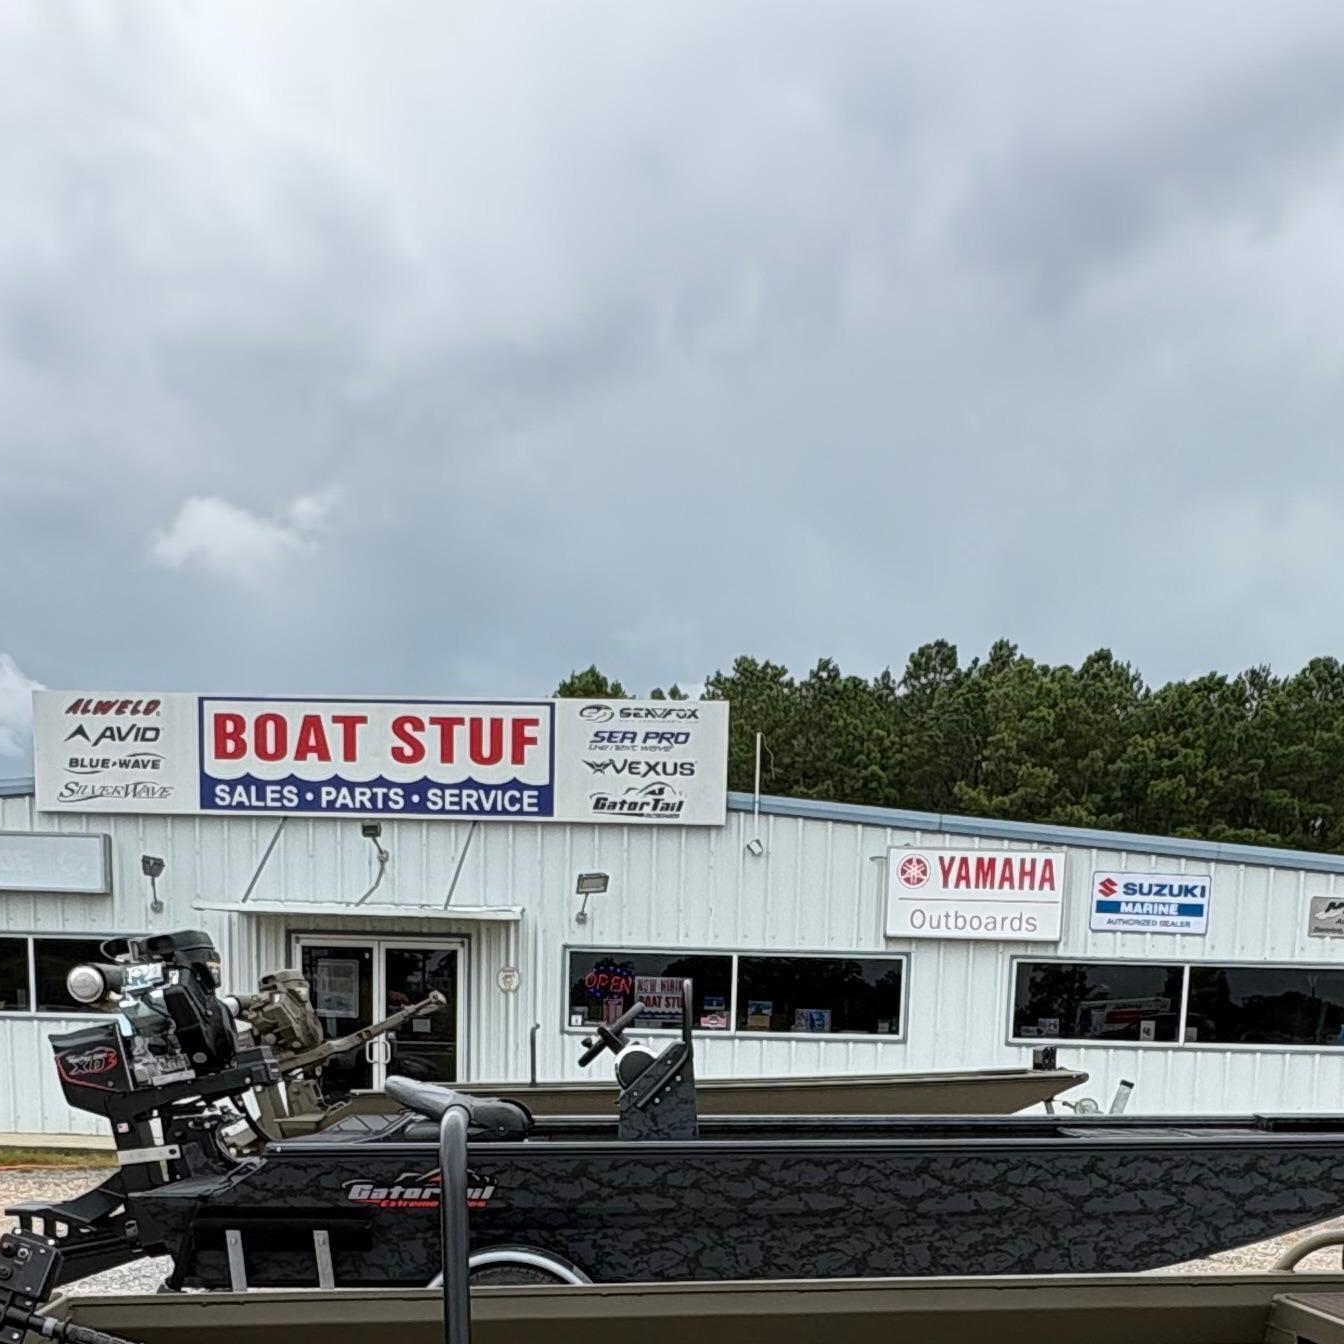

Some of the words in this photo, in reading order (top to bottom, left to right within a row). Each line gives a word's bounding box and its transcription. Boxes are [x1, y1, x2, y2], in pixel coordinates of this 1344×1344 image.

[64, 698, 161, 716] ALWELD
[91, 724, 161, 747] AVID
[213, 713, 368, 762] BOAT
[390, 715, 540, 766] STUF
[589, 730, 638, 744] SEA
[642, 731, 691, 746] PRO
[68, 757, 111, 769] BLUE
[118, 758, 162, 770] WAVE
[609, 758, 696, 778] VEXUS
[214, 784, 299, 808] SALES
[320, 786, 405, 810] PARTS
[426, 788, 540, 812] SERVICE
[938, 856, 1056, 891] YAMAHA
[1122, 882, 1206, 898] SUZUKI
[1120, 901, 1179, 916] MARINE
[910, 908, 1038, 932] Outboards
[584, 972, 633, 994] OPEN
